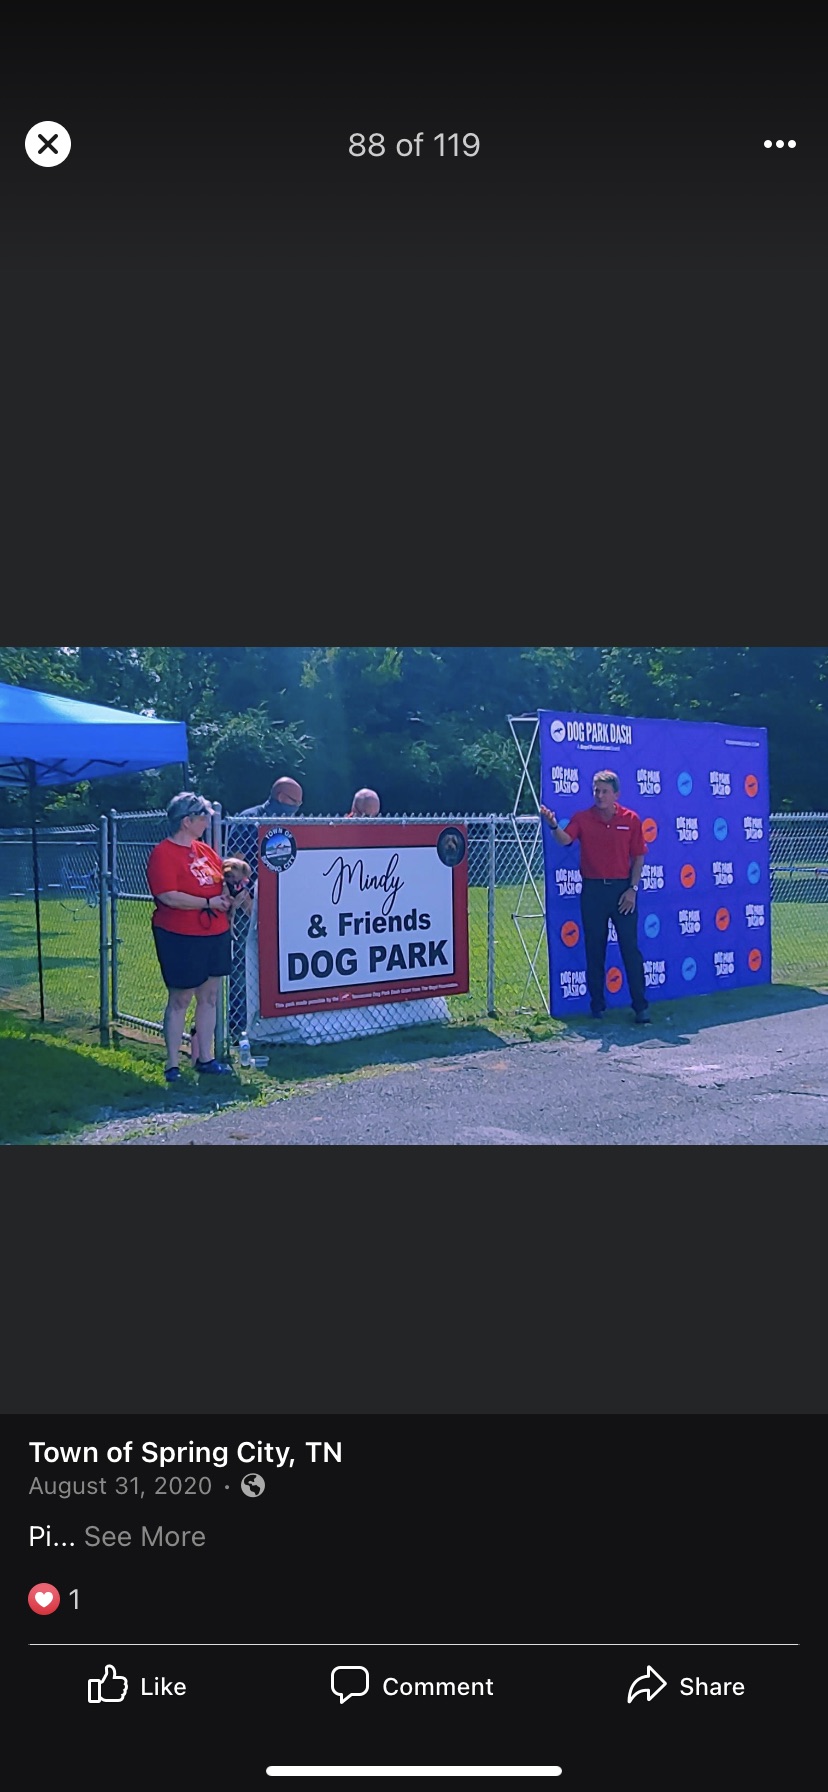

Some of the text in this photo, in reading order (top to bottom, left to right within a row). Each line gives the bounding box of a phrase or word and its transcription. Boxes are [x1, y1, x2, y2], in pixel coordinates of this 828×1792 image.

[567, 721, 632, 745] DOG PARK DASH
[552, 766, 579, 781] DOG PARK
[552, 780, 571, 794] DASH
[265, 827, 293, 839] TOWN OF
[283, 854, 296, 870] CITY
[322, 853, 405, 916] Mindy
[307, 908, 431, 939] & Friends
[287, 939, 449, 982] DOG PARK
[560, 970, 586, 985] DOG PARK
[560, 983, 579, 999] DASH
